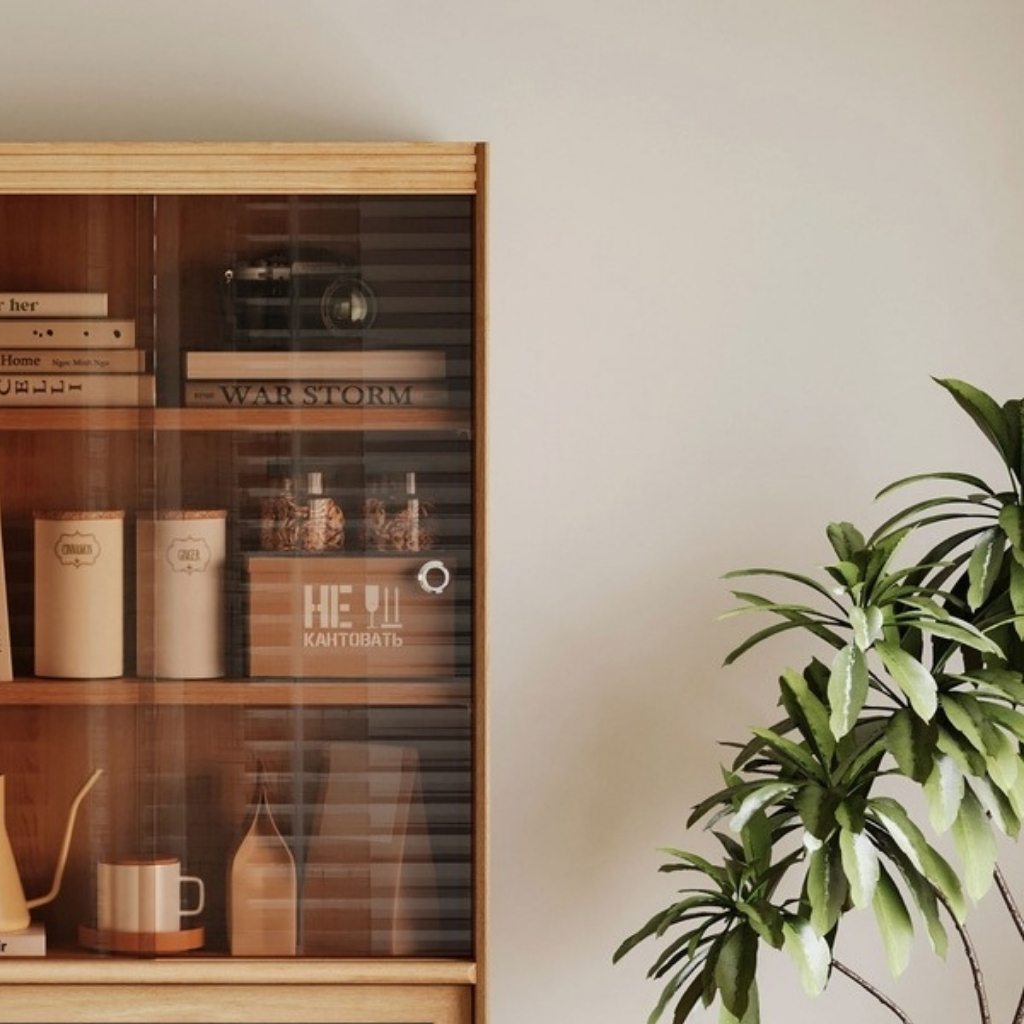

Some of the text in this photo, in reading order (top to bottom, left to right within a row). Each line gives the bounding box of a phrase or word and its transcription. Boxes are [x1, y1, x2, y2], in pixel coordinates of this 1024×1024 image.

[8, 297, 39, 312] her
[0, 354, 41, 366] Home
[219, 385, 414, 406] WAR STORM
[304, 584, 353, 629] НЕ
[303, 632, 404, 647] КАНТОВАТЬ
